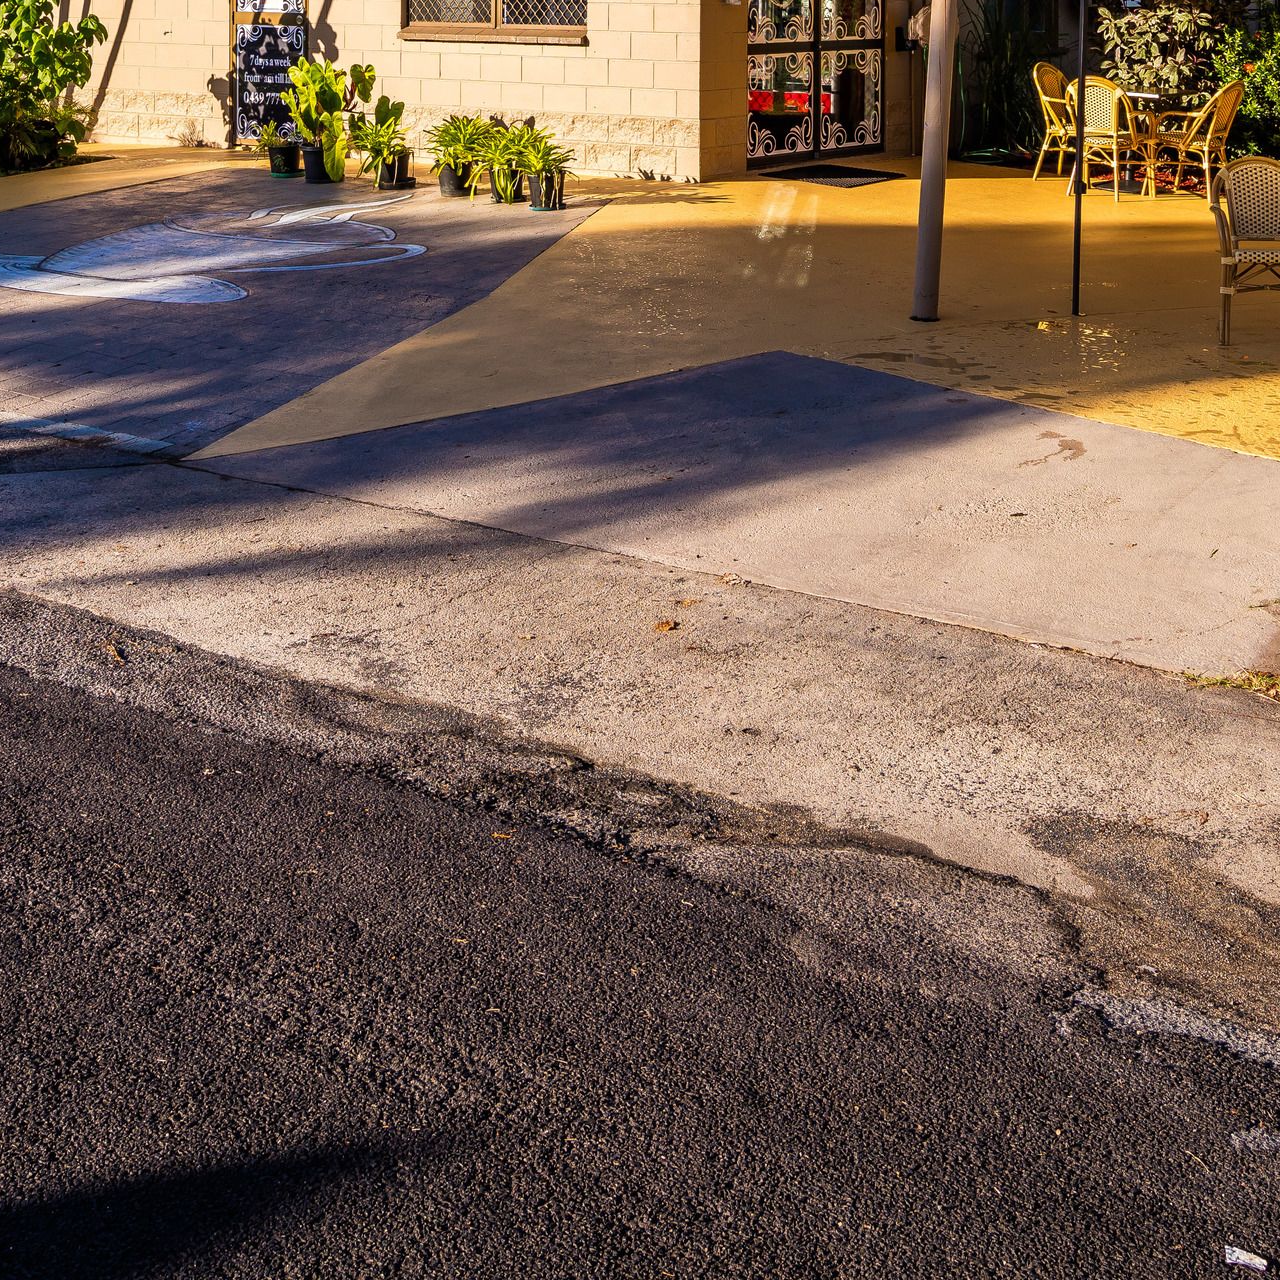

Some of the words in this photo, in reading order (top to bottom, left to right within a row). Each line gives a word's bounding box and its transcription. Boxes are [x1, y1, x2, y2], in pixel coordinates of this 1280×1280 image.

[249, 54, 255, 66] 7
[254, 54, 269, 69] days
[269, 58, 274, 66] a
[274, 55, 292, 67] week
[274, 72, 285, 84] till
[243, 91, 265, 104] 0439
[265, 92, 281, 105] 777
